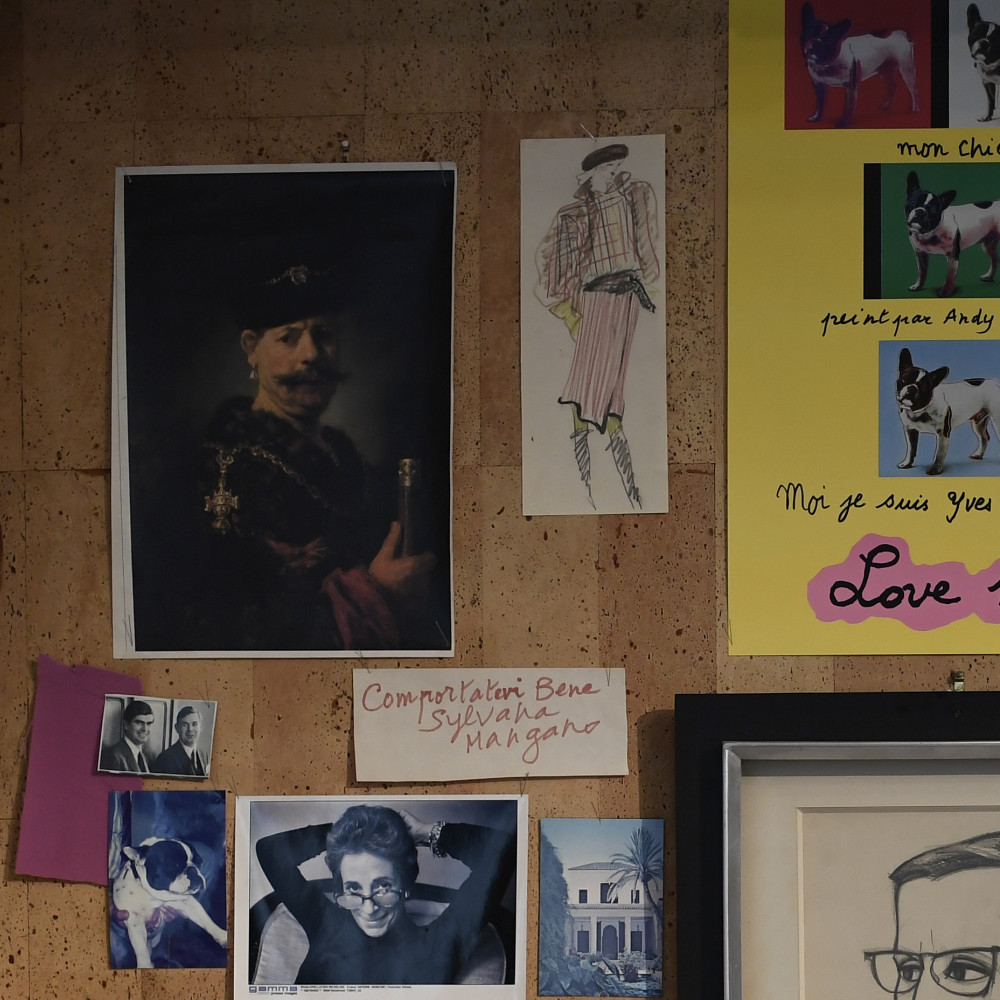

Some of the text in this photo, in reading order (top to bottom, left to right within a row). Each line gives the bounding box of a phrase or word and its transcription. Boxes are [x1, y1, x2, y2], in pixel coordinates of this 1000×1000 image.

[897, 142, 949, 158] mon
[821, 307, 889, 337] peint
[892, 312, 933, 337] par
[943, 308, 994, 334] Andy
[776, 482, 830, 515] Moi
[838, 490, 866, 522] je
[876, 494, 929, 512] suis
[946, 490, 992, 523] Yves
[829, 543, 961, 609] Love
[535, 676, 600, 702] Bene
[418, 702, 560, 744] Sylvana
[466, 718, 600, 764] Mangano
